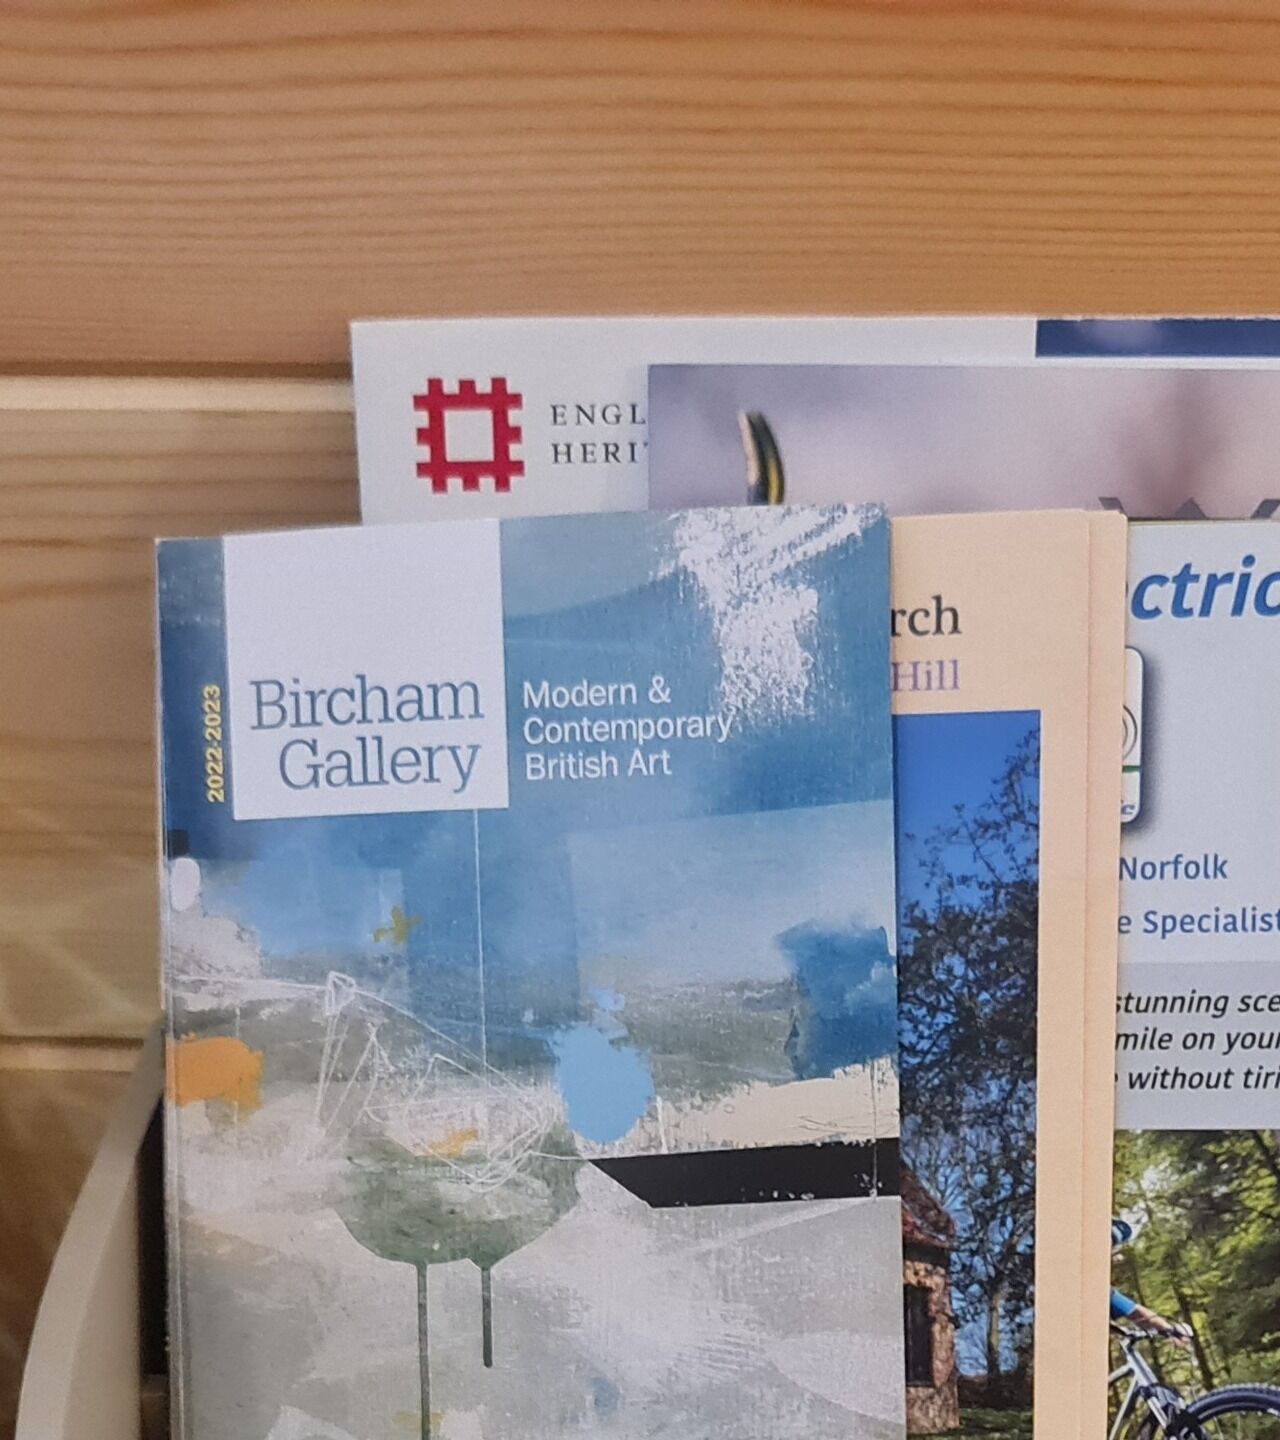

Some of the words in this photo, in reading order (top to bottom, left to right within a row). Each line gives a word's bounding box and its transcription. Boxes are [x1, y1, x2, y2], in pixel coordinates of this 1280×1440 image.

[550, 404, 646, 425] ENGL
[551, 442, 648, 464] HERI
[523, 681, 638, 709] Modern
[648, 675, 672, 704] &
[892, 660, 961, 692] Hill
[250, 672, 484, 730] Bircham
[204, 684, 224, 803] 2022-2023
[523, 711, 734, 745] Contemporary
[277, 737, 482, 793] Gallery
[525, 753, 619, 782] British
[627, 750, 673, 777] Art
[1120, 854, 1229, 881] Norfolk
[1115, 1026, 1174, 1051] mile
[1182, 1031, 1215, 1051] on
[1127, 1066, 1234, 1091] without
